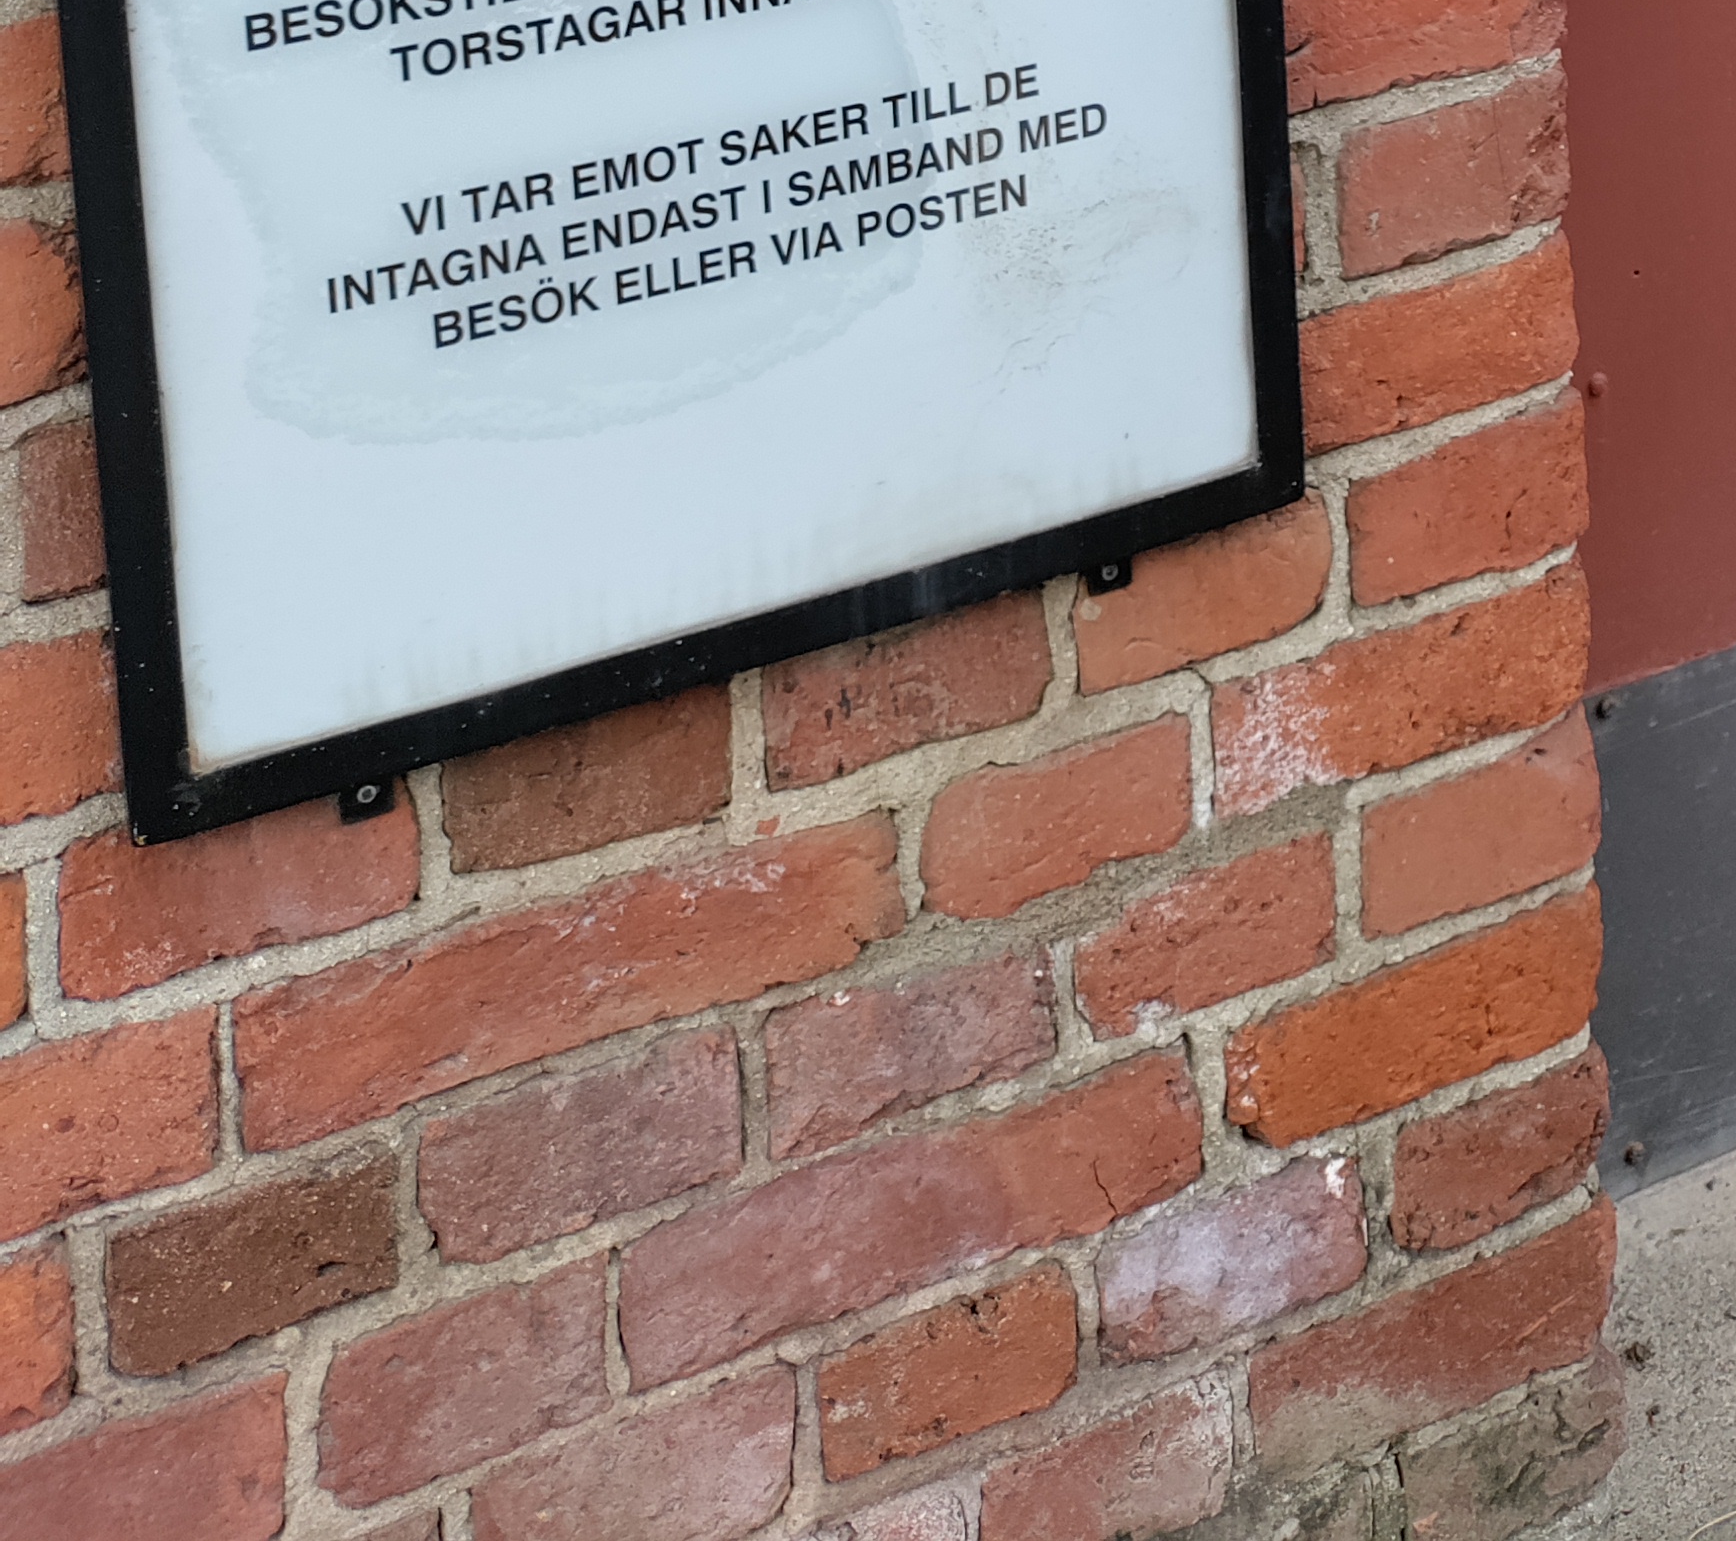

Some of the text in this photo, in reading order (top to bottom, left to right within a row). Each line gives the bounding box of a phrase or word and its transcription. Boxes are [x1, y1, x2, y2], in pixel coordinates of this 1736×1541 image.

[328, 103, 1107, 315] INTAGNA ENDAST I SAMBAND MED
[400, 63, 1040, 236] VI TAR EMOT SAKER TILL DE
[432, 174, 1027, 350] BESÖK ELLER VIA POSTEN
